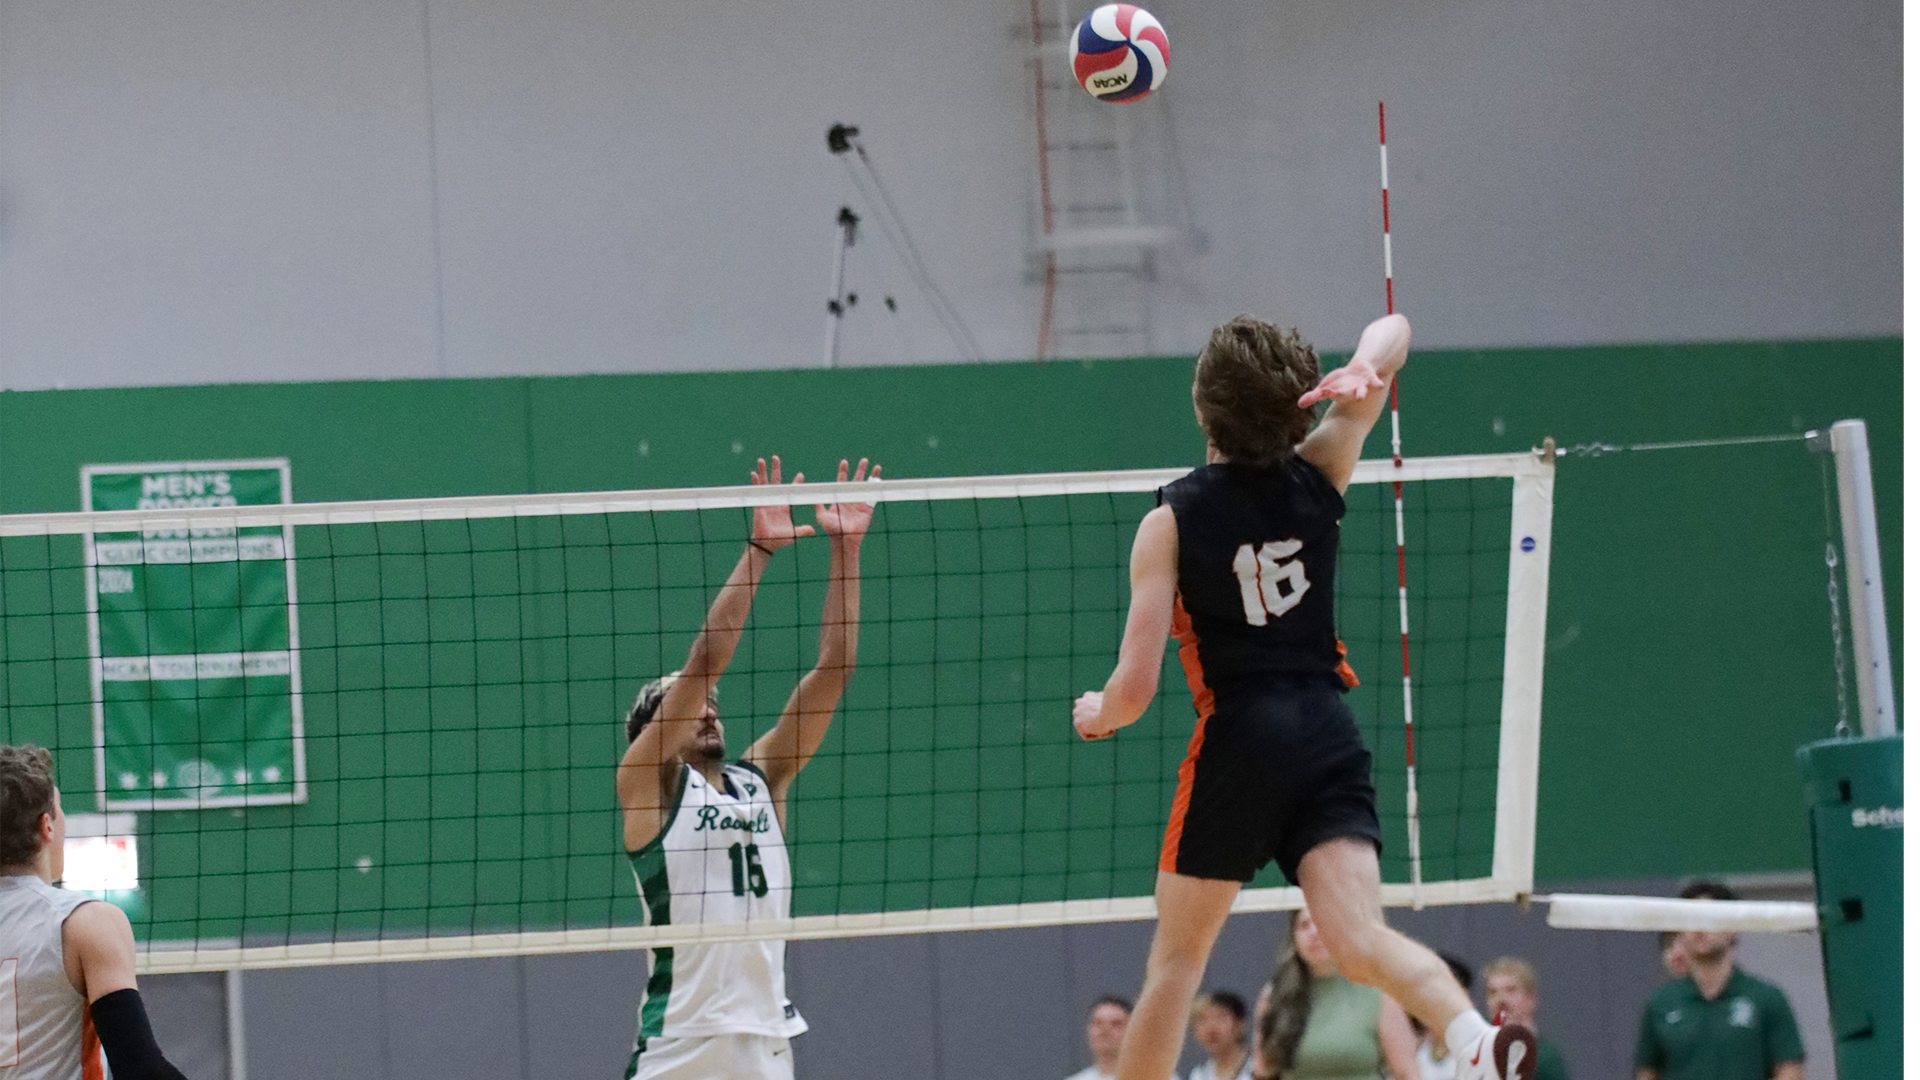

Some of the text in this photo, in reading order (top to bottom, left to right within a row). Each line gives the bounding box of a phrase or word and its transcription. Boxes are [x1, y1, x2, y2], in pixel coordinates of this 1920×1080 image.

[1093, 74, 1128, 88] NCAA
[141, 472, 231, 497] MEN'S
[1232, 538, 1311, 627] 16
